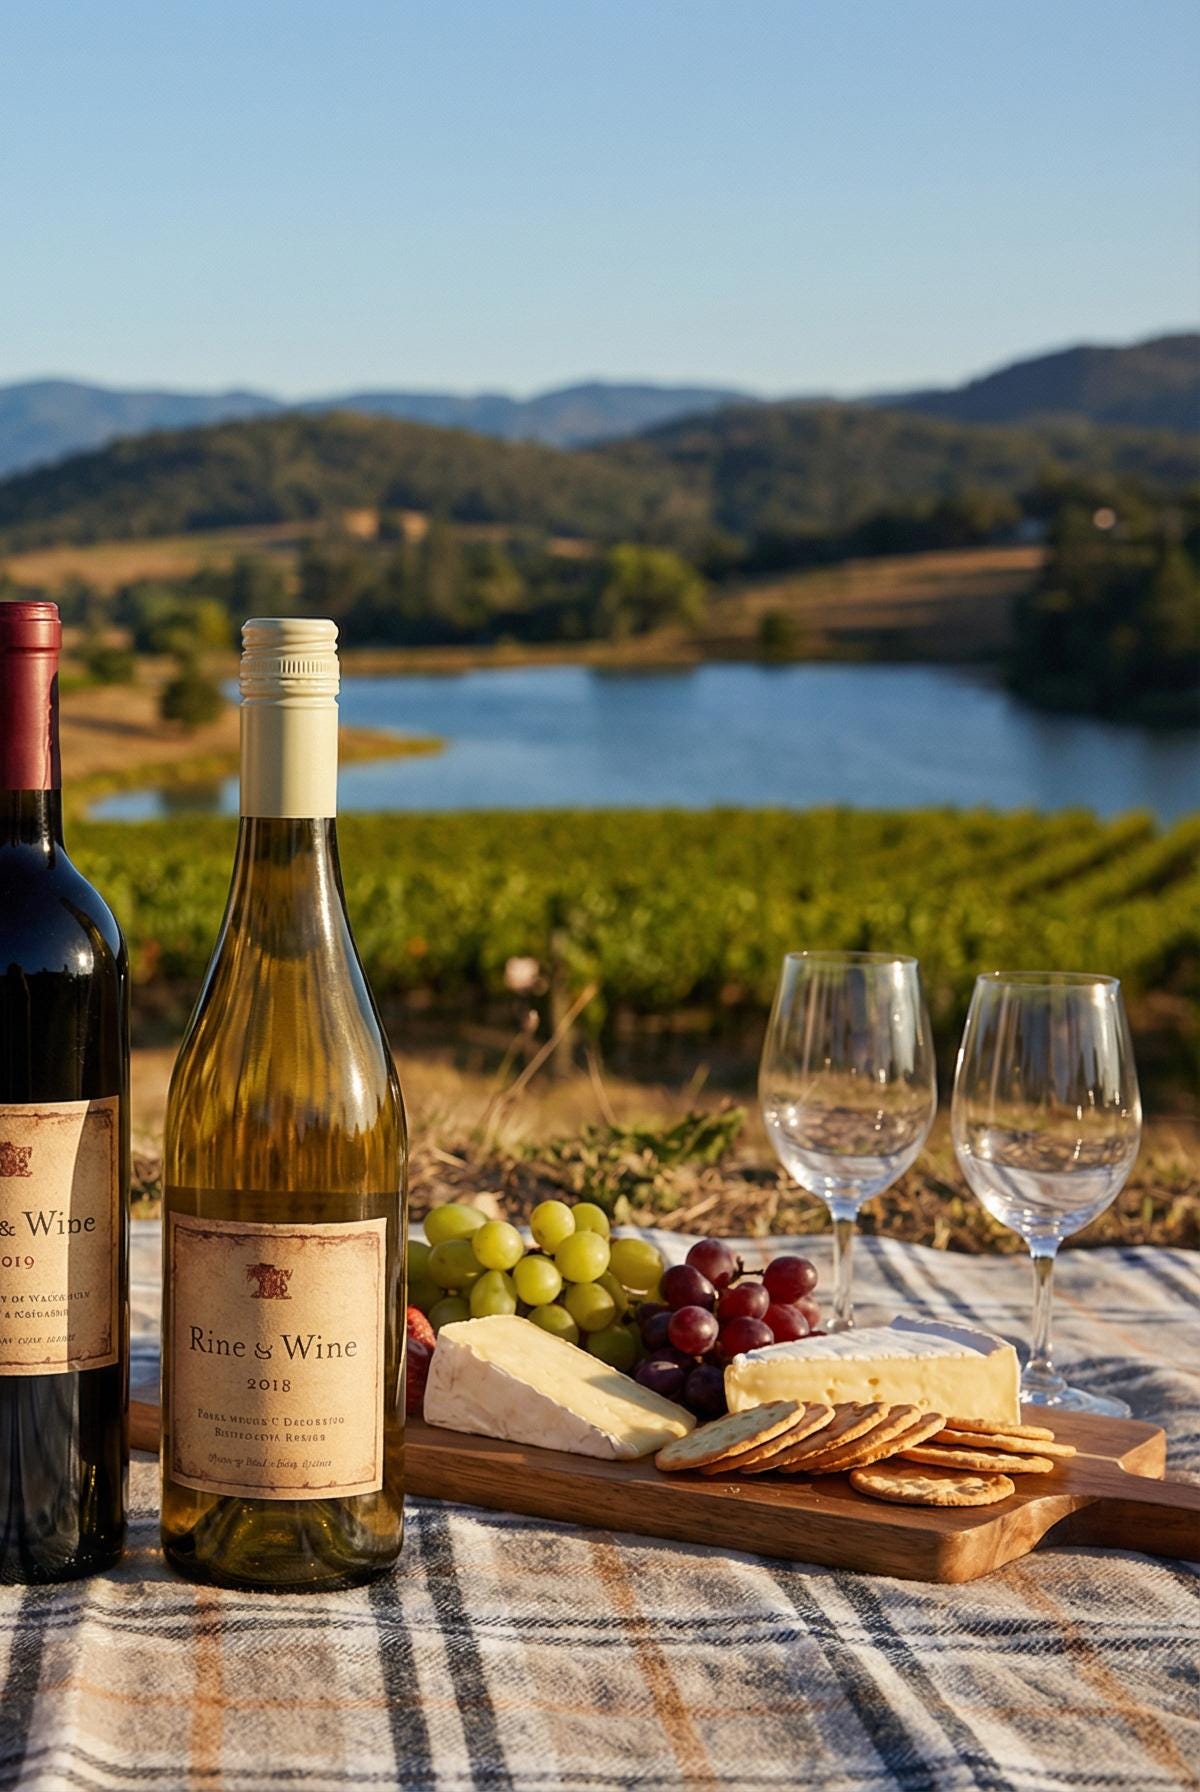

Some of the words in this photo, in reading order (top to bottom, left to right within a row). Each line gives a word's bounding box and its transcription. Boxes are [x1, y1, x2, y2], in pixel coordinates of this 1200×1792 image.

[189, 1325, 246, 1358] Rine
[280, 1333, 357, 1360] Wine
[247, 1378, 291, 1393] 2018
